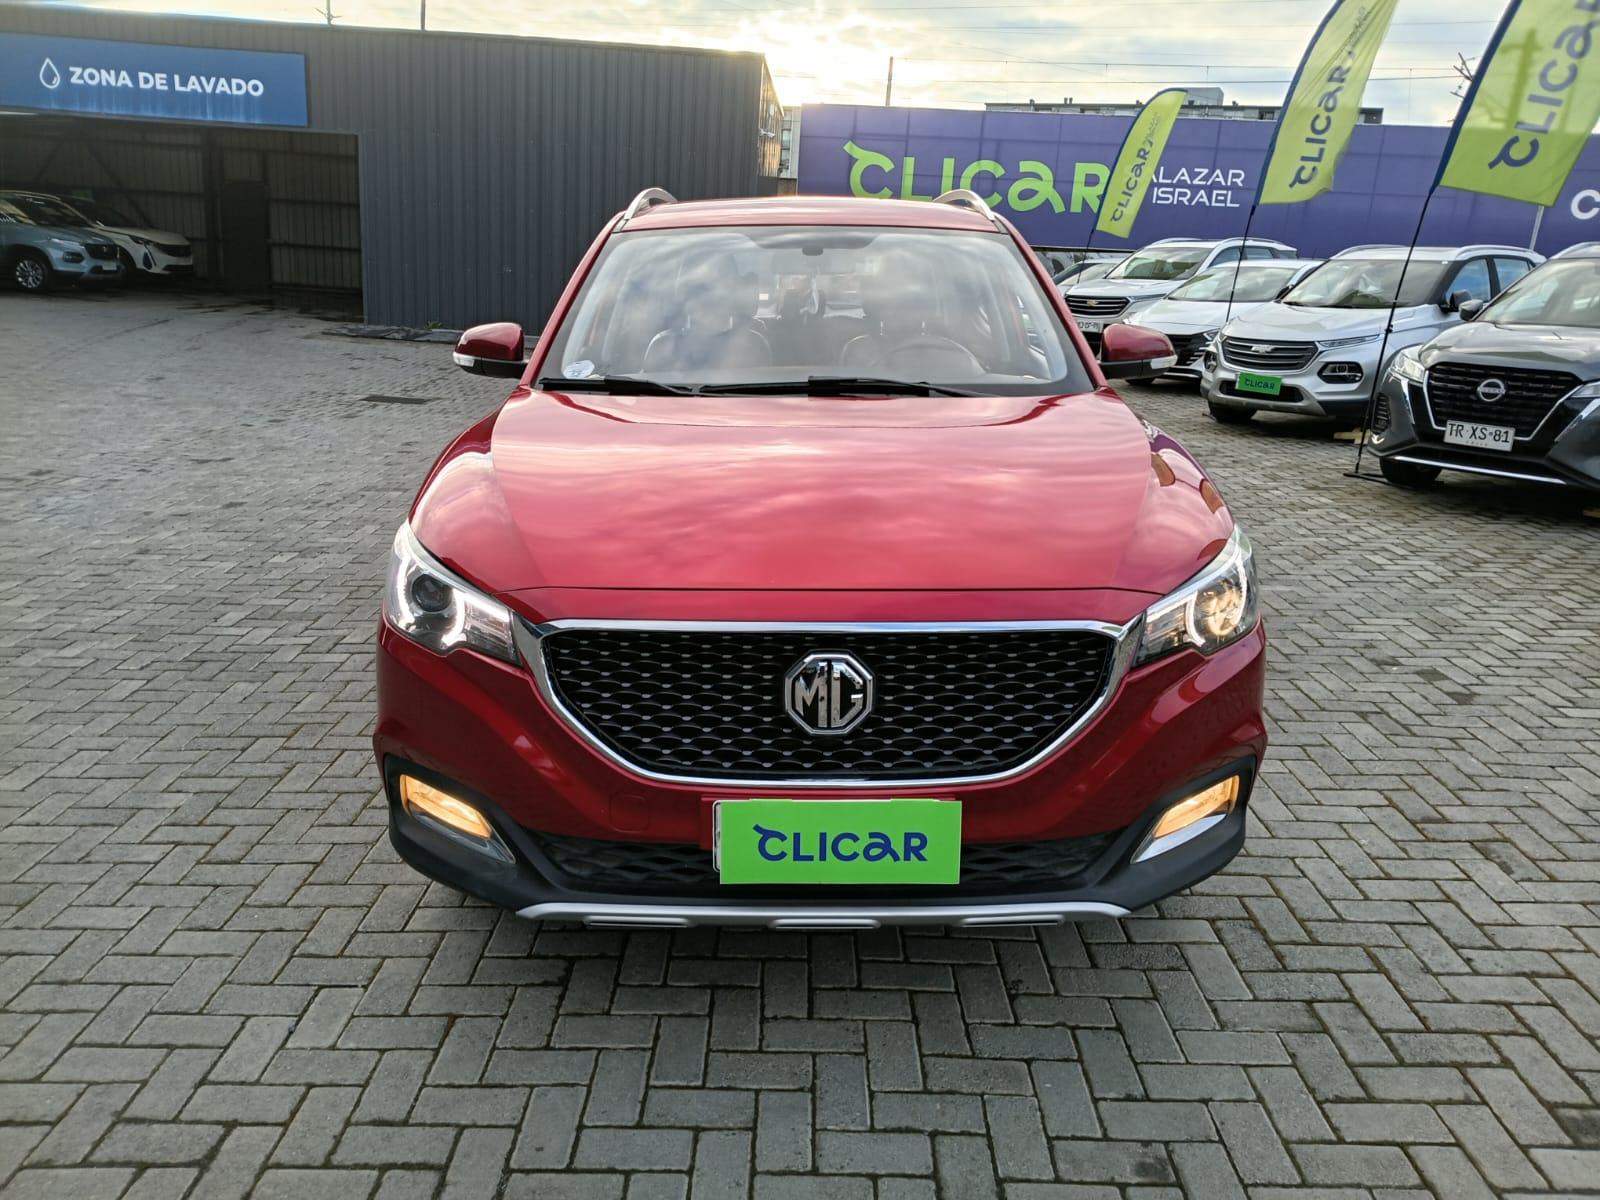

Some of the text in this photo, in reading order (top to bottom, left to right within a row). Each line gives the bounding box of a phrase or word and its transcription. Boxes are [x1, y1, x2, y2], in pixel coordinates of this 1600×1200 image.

[69, 66, 264, 97] ZONA DE LAVADO
[1152, 187, 1240, 207] ISRAEL
[794, 660, 863, 728] MG
